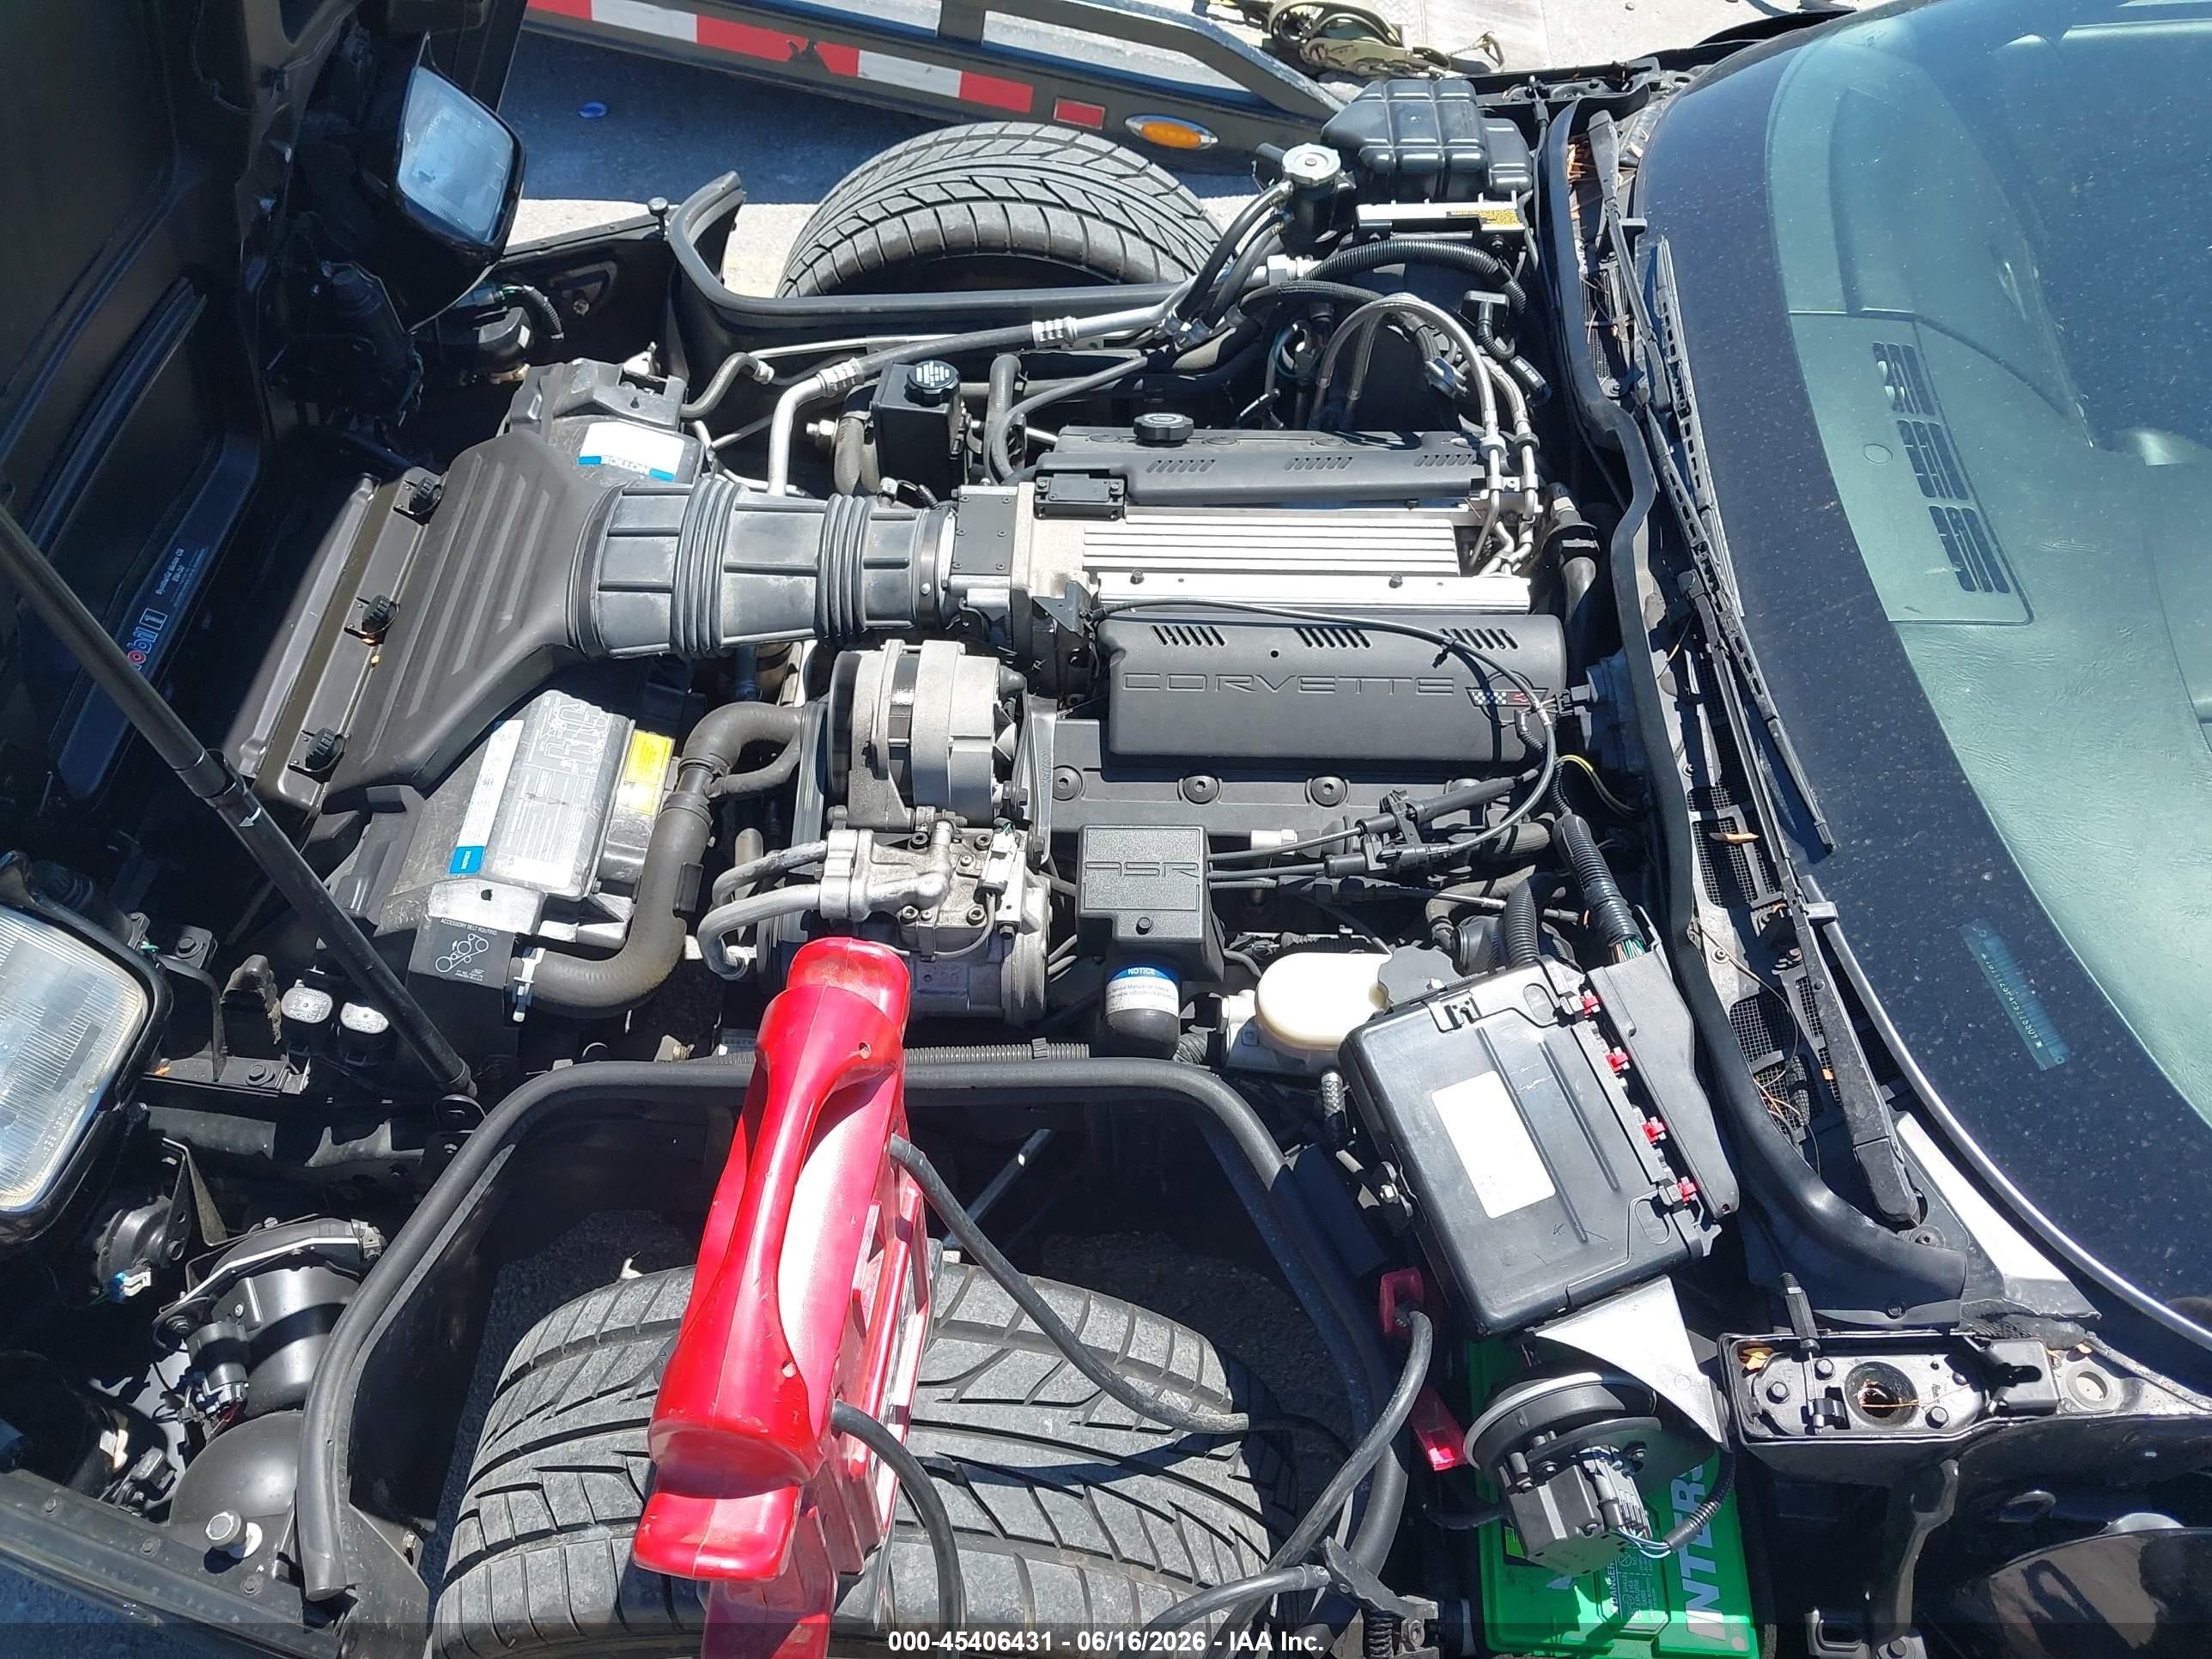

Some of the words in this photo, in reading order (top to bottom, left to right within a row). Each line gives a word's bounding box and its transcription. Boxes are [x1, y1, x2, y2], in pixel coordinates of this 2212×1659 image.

[601, 456, 647, 474] NOTICE
[127, 627, 158, 670] obil
[1121, 672, 1455, 696] CORVETTE
[461, 851, 471, 869] NOTICE
[1084, 861, 1200, 878] ASR
[441, 918, 466, 927] ACCESSORY
[1607, 1563, 1617, 1603] DANGER
